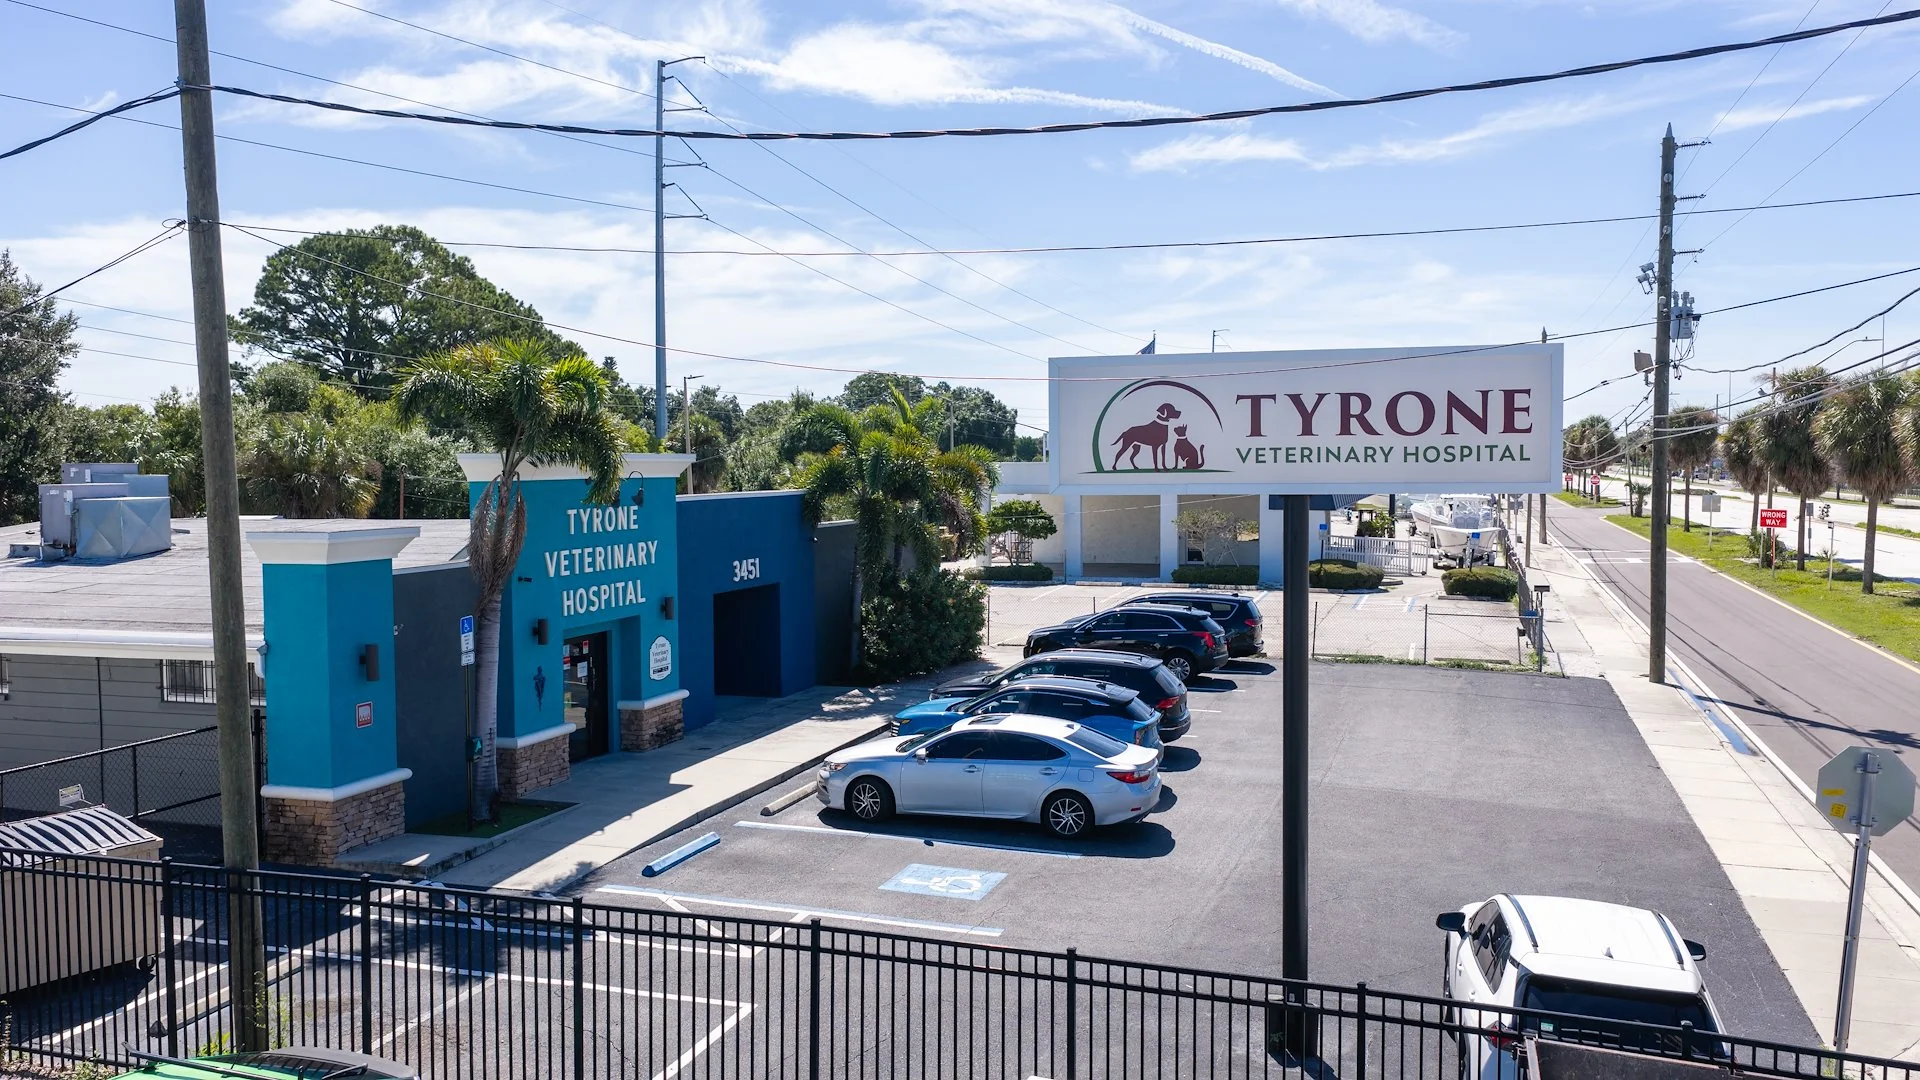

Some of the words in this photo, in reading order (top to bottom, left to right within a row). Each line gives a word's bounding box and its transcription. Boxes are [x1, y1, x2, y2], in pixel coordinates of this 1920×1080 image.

[1235, 388, 1533, 438] TYRONE
[1235, 446, 1395, 464] VETERINARY
[1403, 444, 1531, 463] HOSPITAL
[566, 505, 639, 535] TYRONE
[544, 540, 658, 578] VETERINARY
[732, 557, 760, 582] 3451
[562, 579, 646, 617] HOSPITAL
